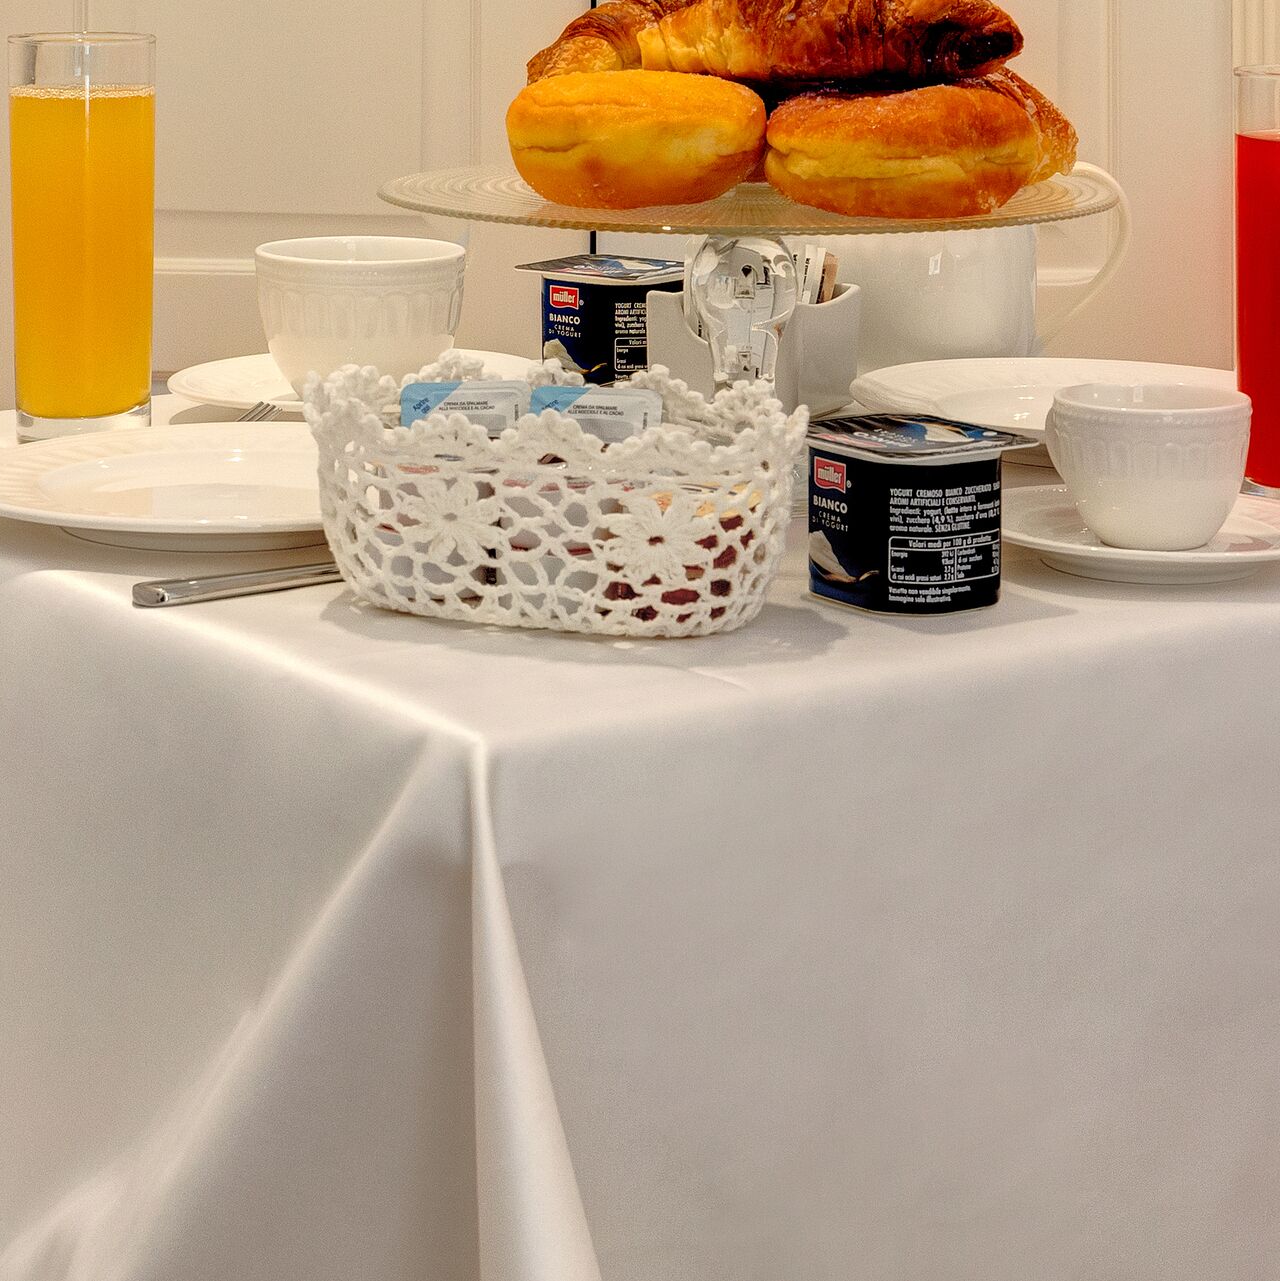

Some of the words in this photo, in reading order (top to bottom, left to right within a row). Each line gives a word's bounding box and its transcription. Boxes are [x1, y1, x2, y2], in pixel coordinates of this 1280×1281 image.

[553, 291, 575, 304] müller
[549, 313, 581, 325] BIANCO
[554, 324, 575, 332] CREMA
[557, 330, 581, 338] YOGURT
[817, 465, 842, 484] müller
[889, 488, 913, 497] YOGURT
[915, 489, 943, 498] CREMOSO
[812, 494, 848, 514] BIANCO
[818, 510, 841, 523] CREMA
[821, 519, 848, 532] YOGURT
[908, 539, 927, 548] Valori
